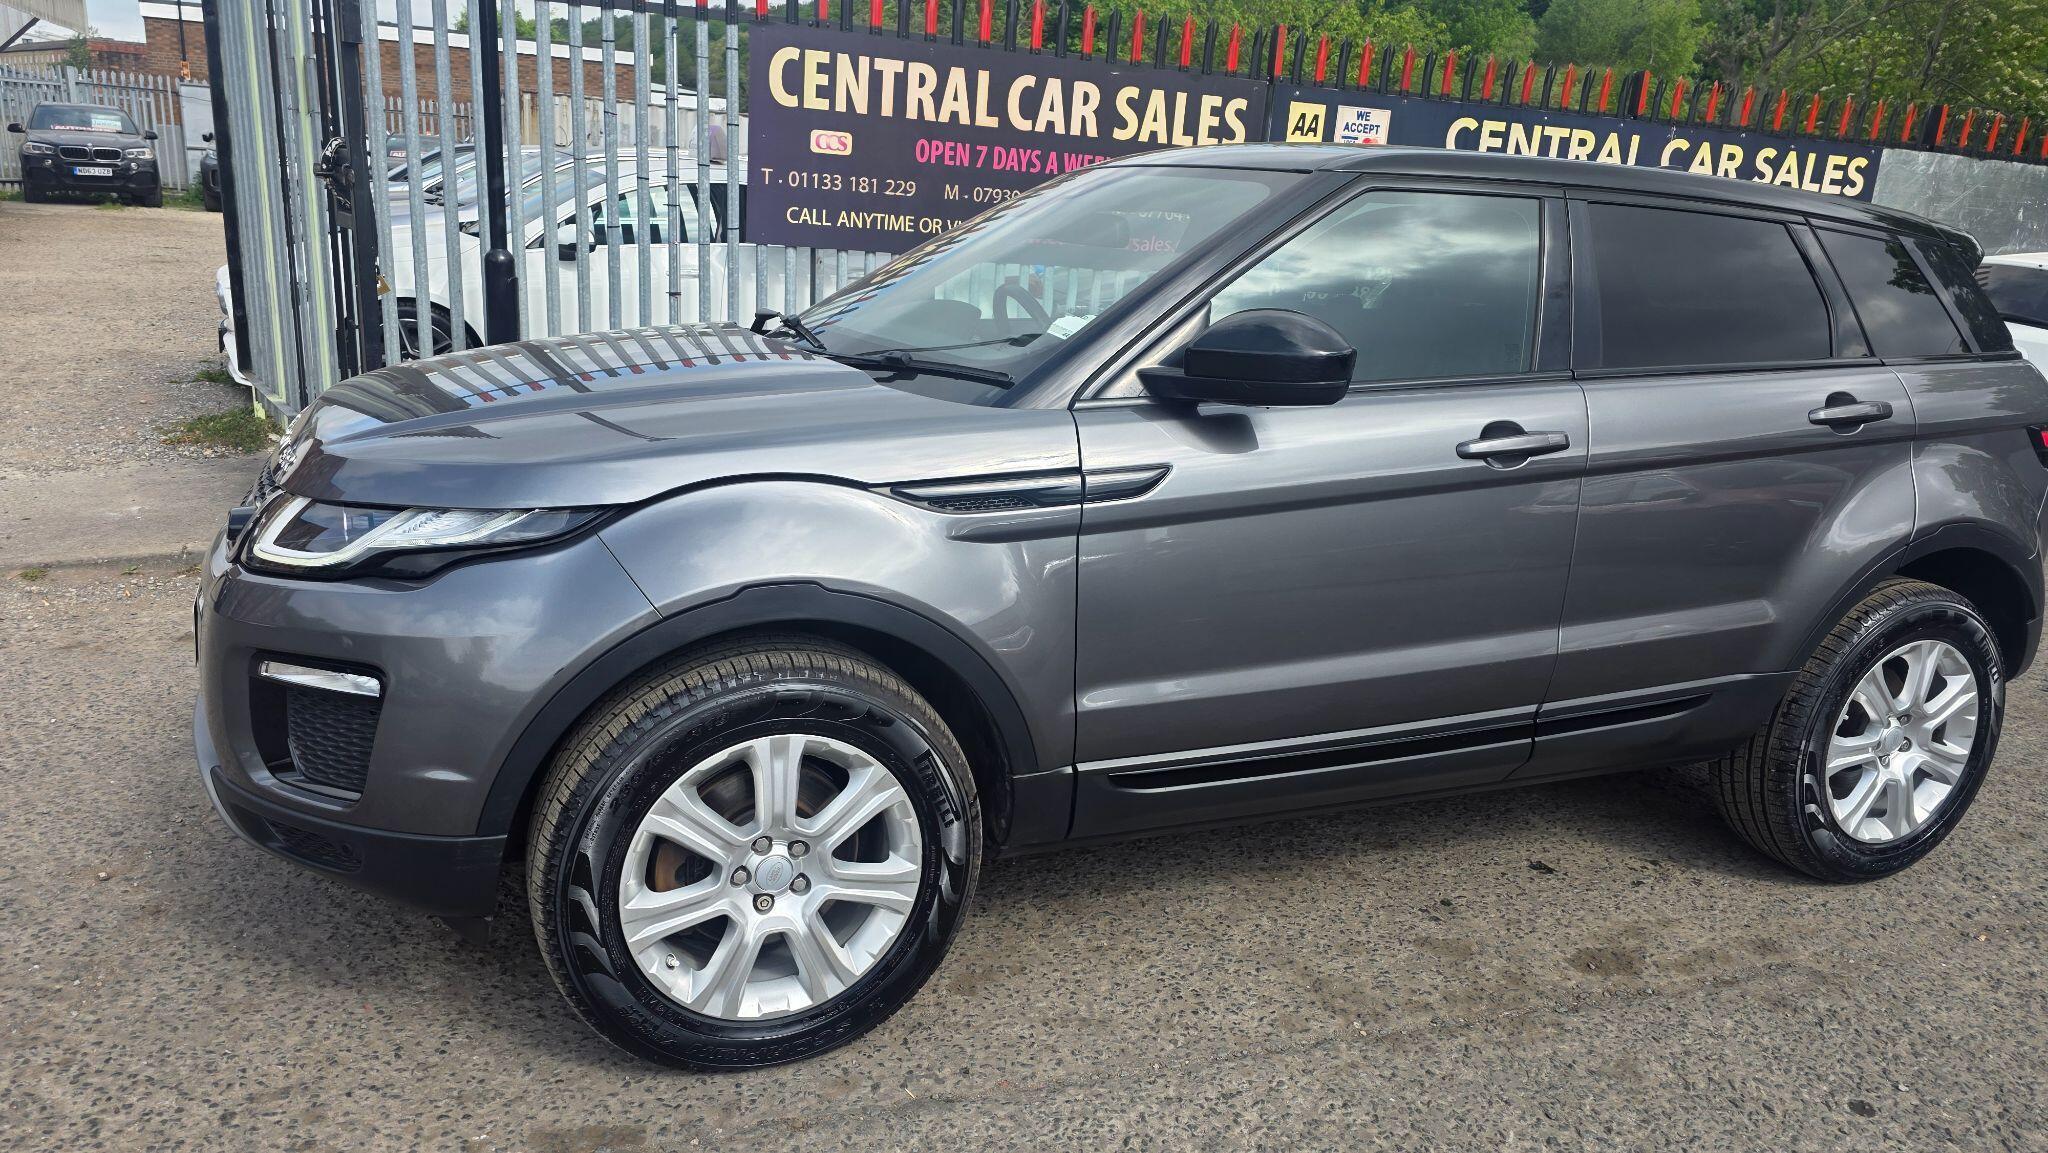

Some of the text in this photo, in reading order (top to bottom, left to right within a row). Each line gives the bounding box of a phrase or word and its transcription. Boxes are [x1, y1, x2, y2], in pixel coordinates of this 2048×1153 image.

[768, 46, 1248, 146] CENTRAL CAR SALES
[1291, 112, 1320, 137] AA
[1343, 122, 1380, 135] ACCEPT
[1357, 110, 1372, 121] WE
[815, 133, 848, 152] CCS
[915, 138, 970, 168] OPEN
[975, 145, 988, 168] 7
[992, 146, 1042, 174] DAYS
[1045, 151, 1058, 175] A
[1446, 117, 1869, 197] CENTRAL CAR SALES
[788, 171, 842, 191] 01133
[850, 176, 877, 194] 181
[884, 179, 917, 197] 229
[786, 206, 831, 227] CALL
[836, 210, 915, 233] ANYTIME
[919, 217, 943, 234] OR
[913, 748, 961, 829] PIRELLI
